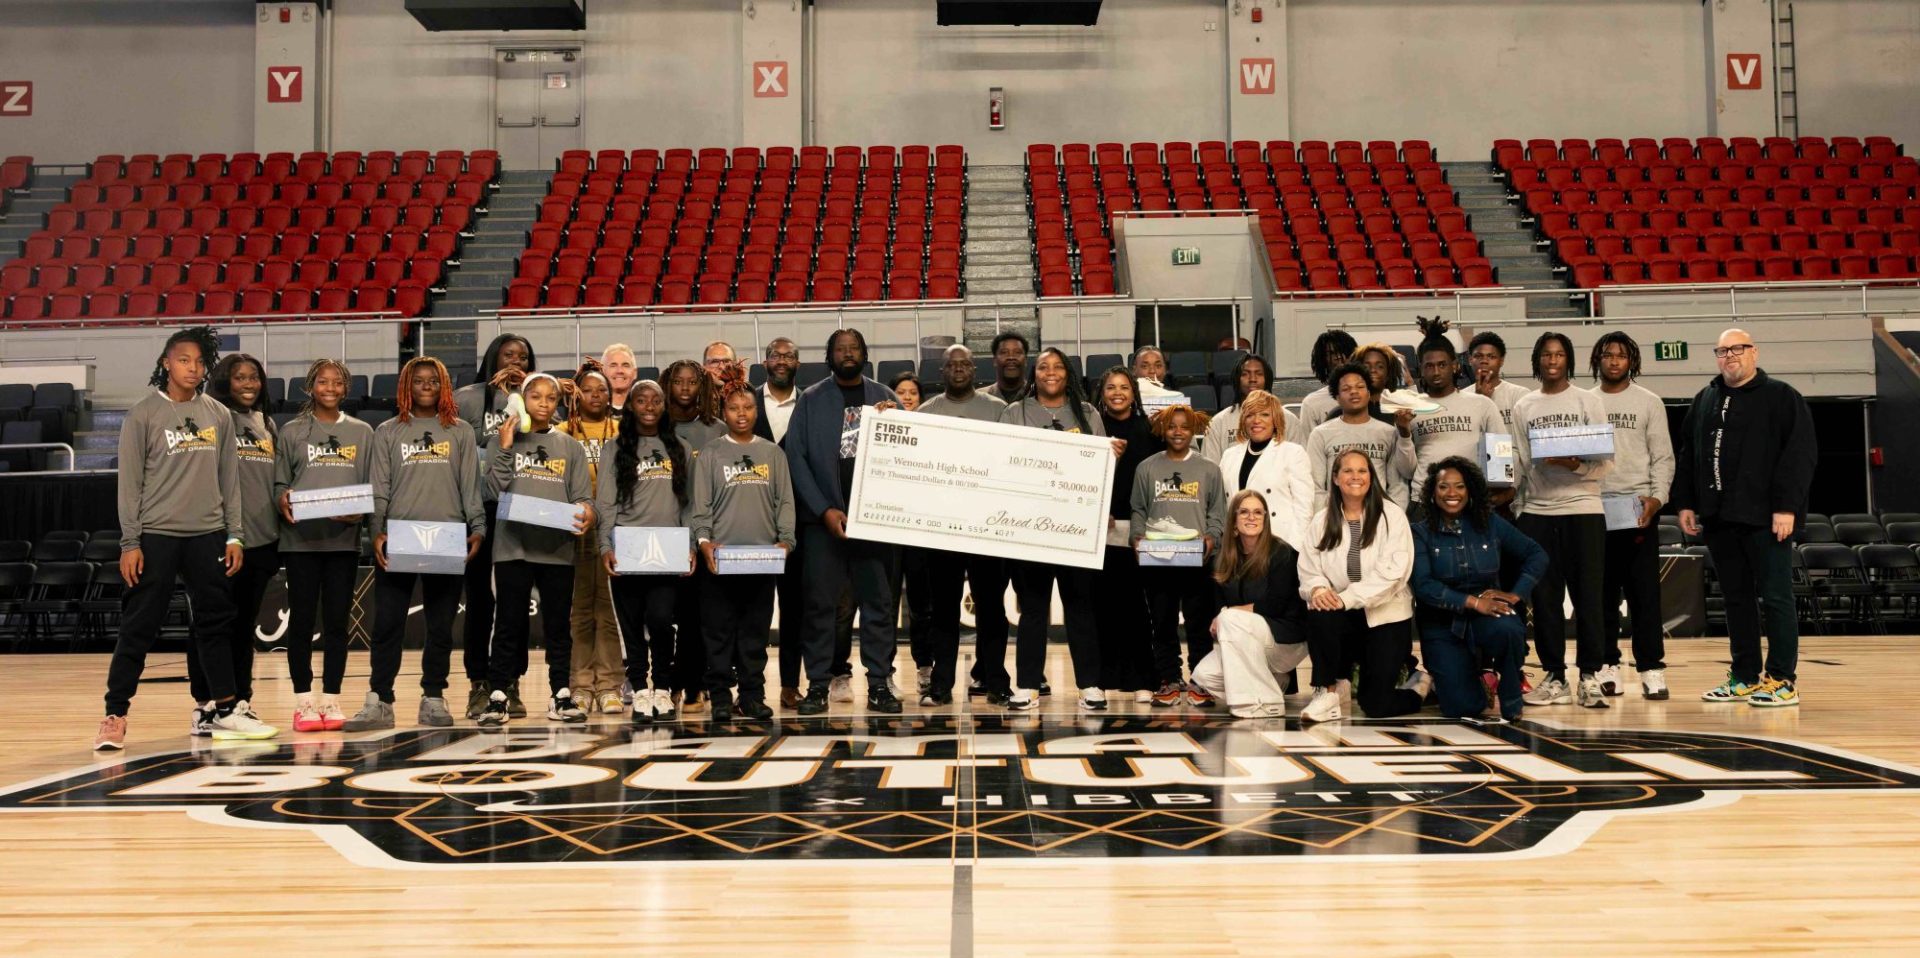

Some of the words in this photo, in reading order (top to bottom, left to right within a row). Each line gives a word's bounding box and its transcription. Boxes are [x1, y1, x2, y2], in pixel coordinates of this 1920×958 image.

[1242, 63, 1272, 89] W
[1730, 58, 1758, 85] V
[271, 71, 299, 98] Y
[757, 66, 785, 93] X
[3, 86, 28, 112] Z
[1178, 249, 1198, 263] EXIT
[1662, 343, 1682, 359] EXIT
[1417, 416, 1471, 429] WENONAH
[1528, 413, 1579, 427] WENONAH
[1607, 413, 1637, 422] ONAH
[876, 422, 911, 435] F1RST
[1417, 424, 1472, 436] BASKETBALL
[874, 432, 918, 446] STRING
[167, 448, 186, 456] LADY
[1079, 450, 1096, 458] 1027
[893, 457, 934, 470] Wenonah
[936, 462, 958, 475] High
[959, 464, 989, 477] School
[1008, 456, 1058, 470] 10/17/2024
[887, 471, 920, 481] Thousand
[922, 475, 946, 485] Dollars
[985, 510, 1032, 528] Jared
[1033, 516, 1088, 536] Briskin
[408, 731, 1207, 761] BAMA
[108, 753, 1817, 795] BOUTWELL
[941, 791, 1424, 806] HIBBETT
